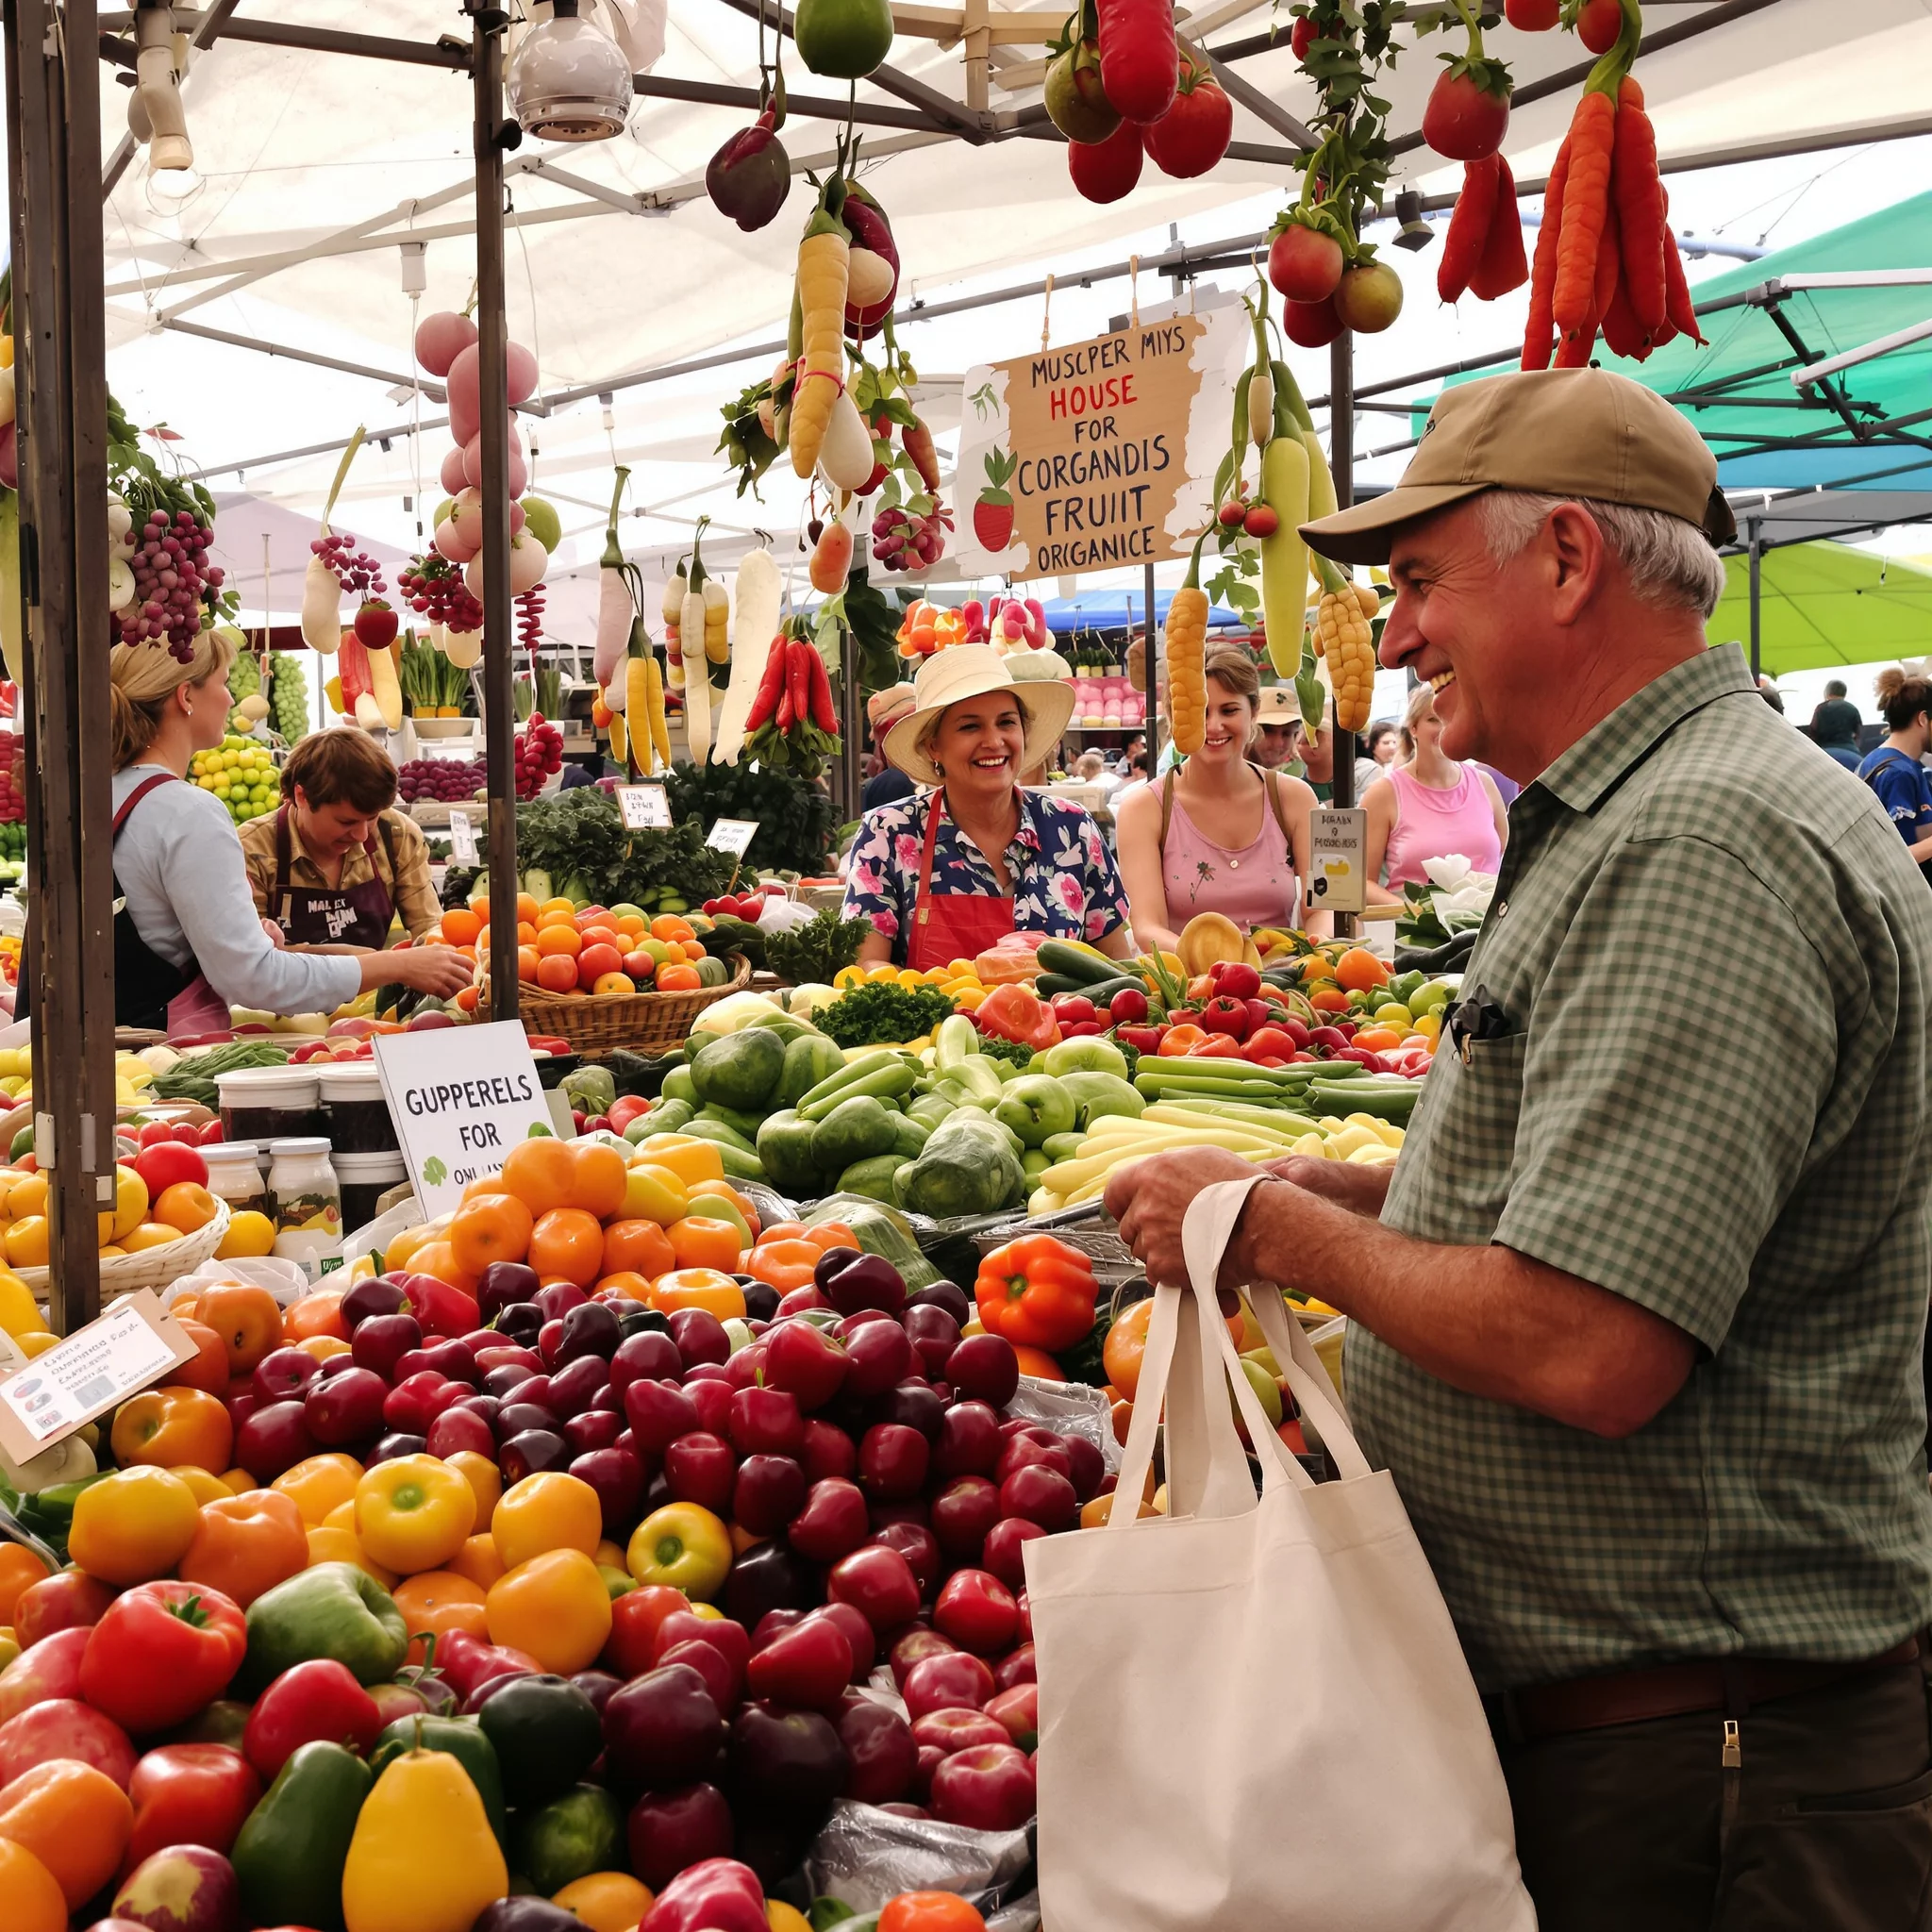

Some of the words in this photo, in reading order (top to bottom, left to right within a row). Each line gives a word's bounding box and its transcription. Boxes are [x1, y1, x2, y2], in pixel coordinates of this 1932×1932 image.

[1032, 339, 1130, 388] MUSCPER
[1141, 326, 1186, 358] MIYS
[1050, 374, 1138, 420] HOUSE
[1074, 415, 1119, 443] FOR
[1018, 434, 1170, 496] CORGANDIS
[405, 1074, 533, 1116] GUPPERELS
[458, 1123, 502, 1151] FOR
